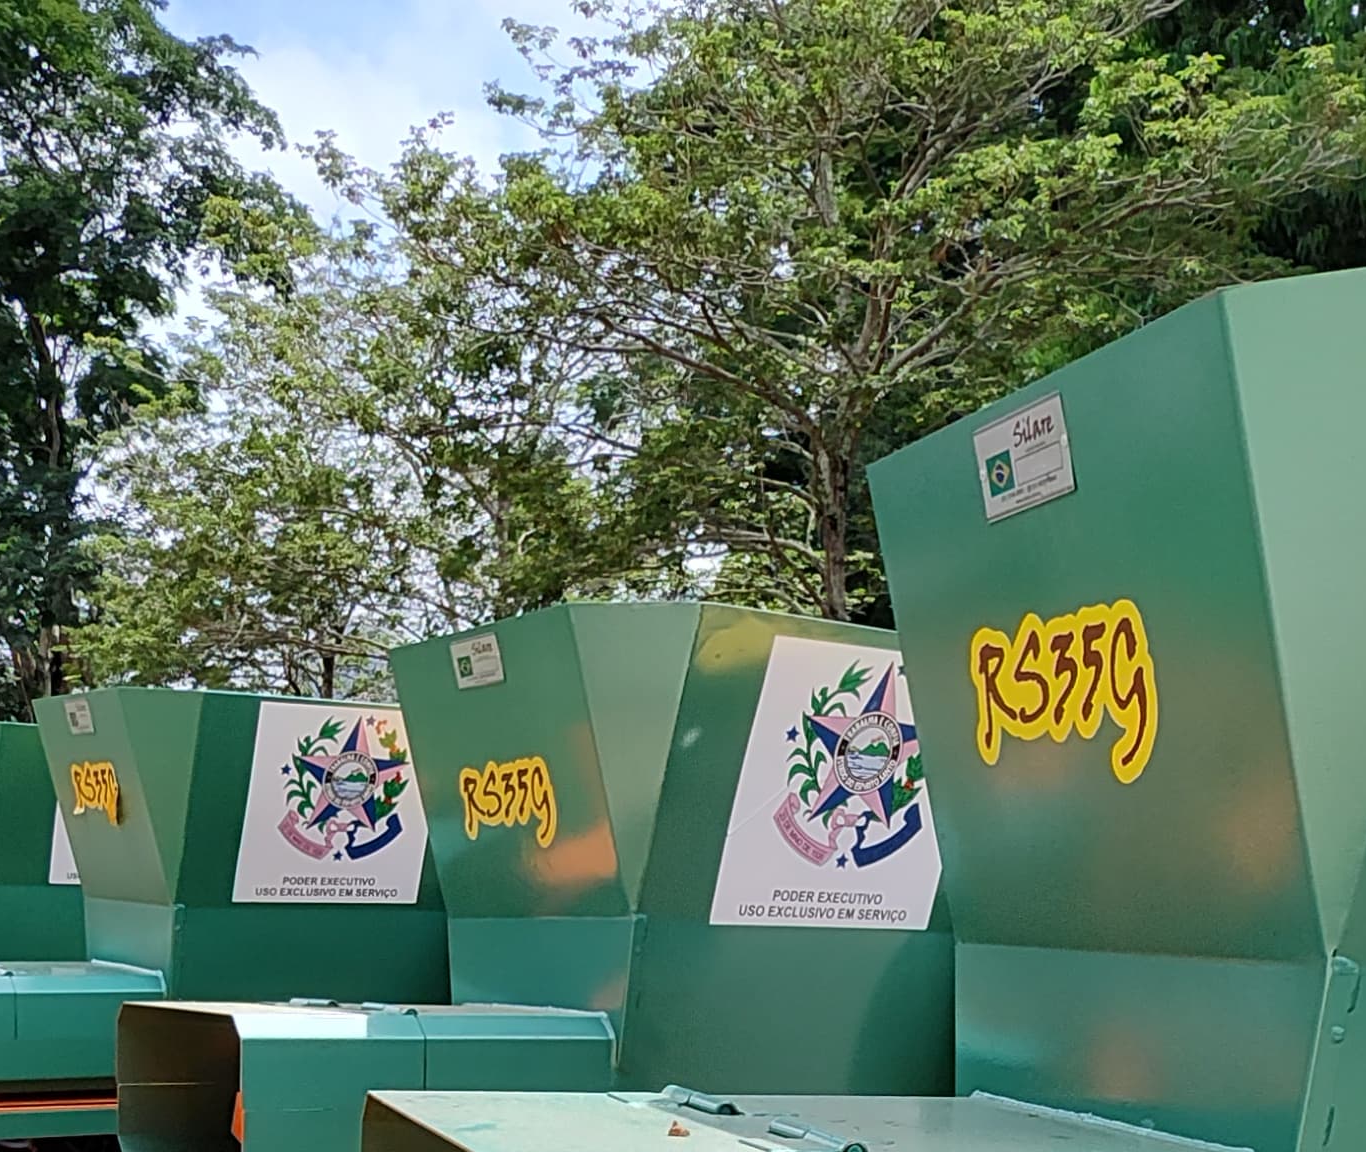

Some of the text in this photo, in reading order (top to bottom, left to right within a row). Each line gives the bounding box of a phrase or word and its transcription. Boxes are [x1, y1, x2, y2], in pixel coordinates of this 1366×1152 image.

[282, 876, 376, 887] PODER EXECUTIVO
[255, 887, 399, 900] USO EXCLUSIVO EM SERVIÇO
[772, 889, 884, 905] PODER EXECUTIVO
[738, 904, 908, 923] USO EXCLUSIVO EM SERVIÇO
